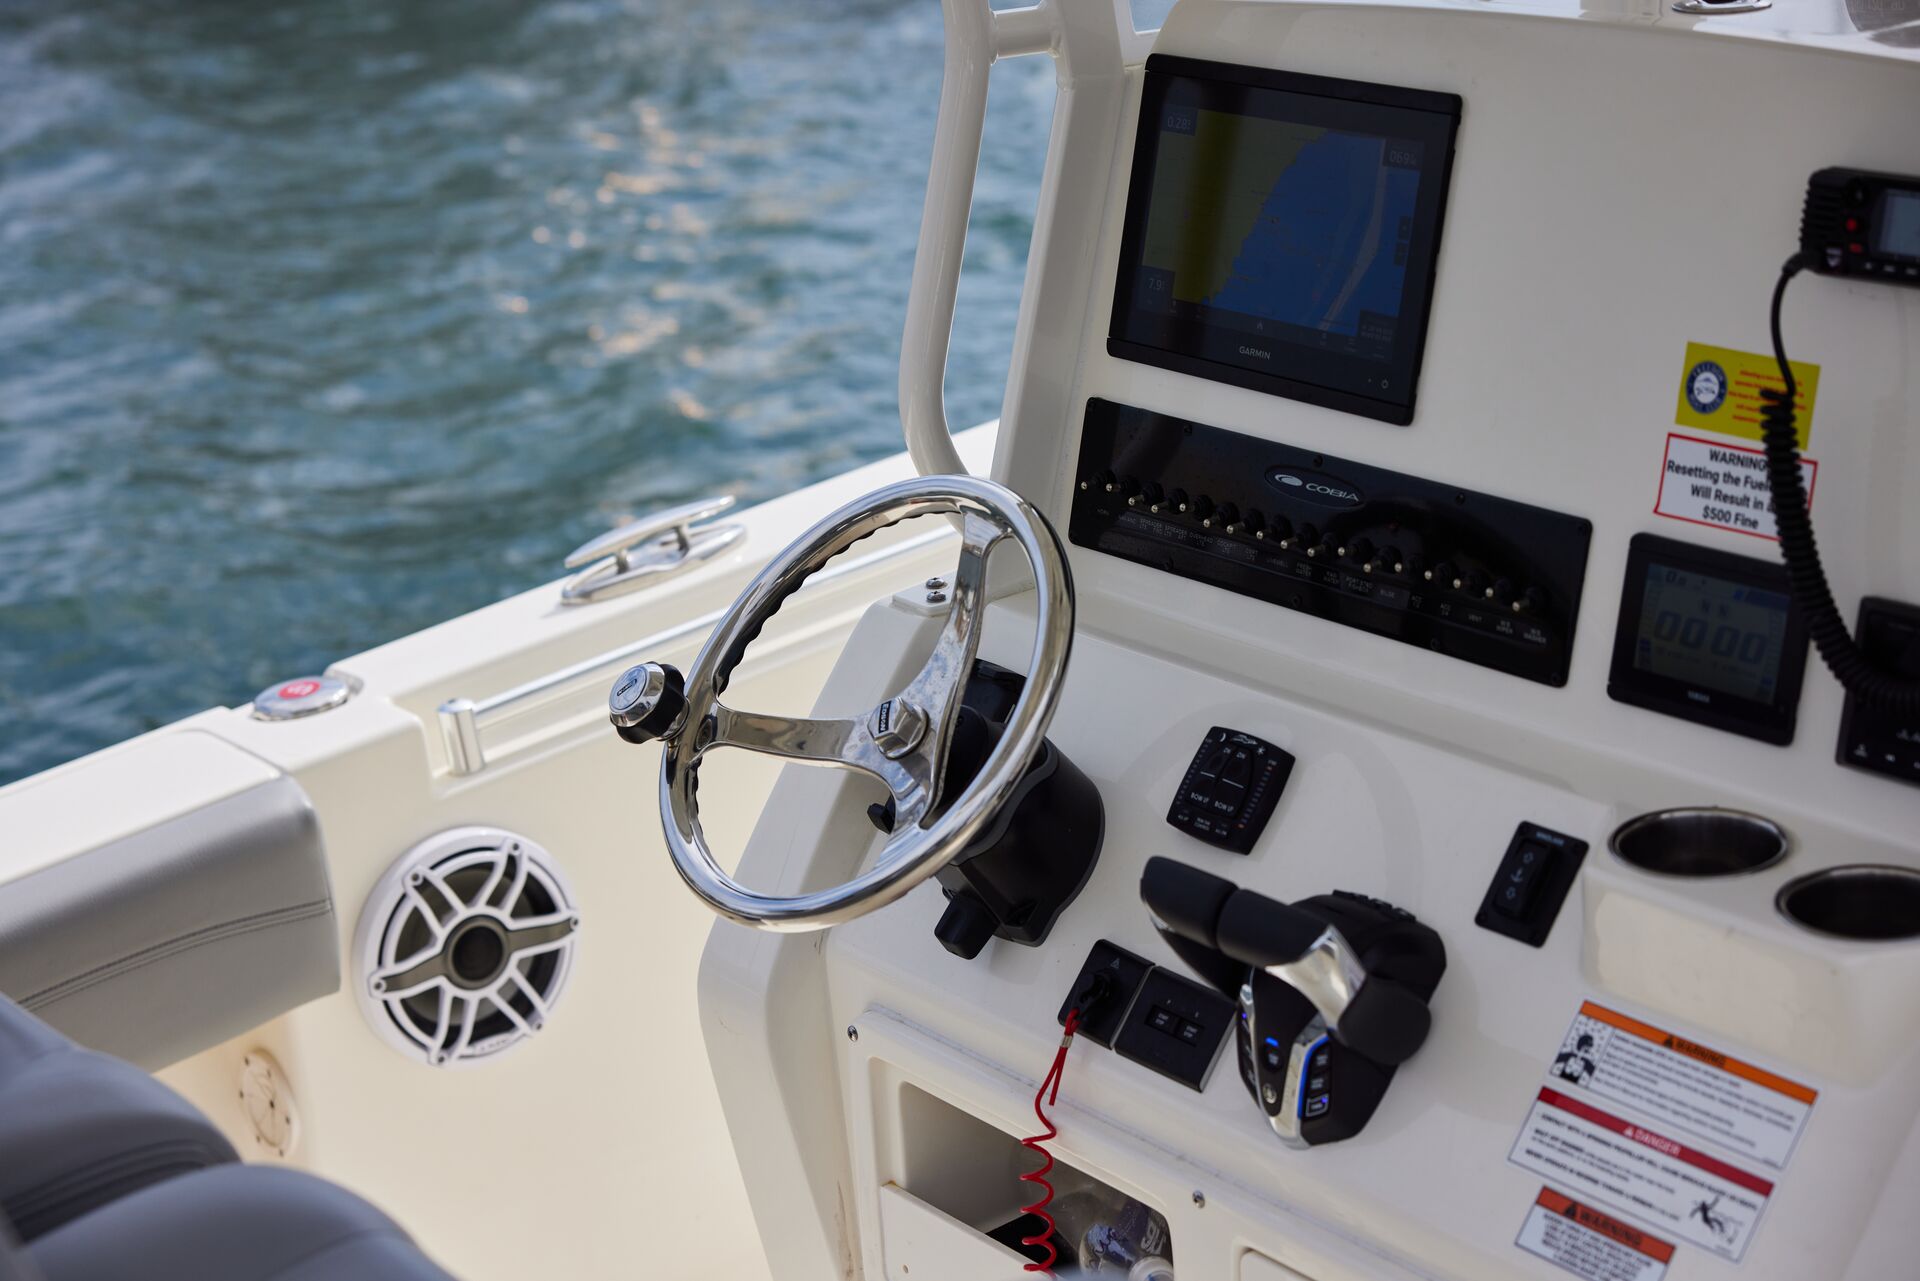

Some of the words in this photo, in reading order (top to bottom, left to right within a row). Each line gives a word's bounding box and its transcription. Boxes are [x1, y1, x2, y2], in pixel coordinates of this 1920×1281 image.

[1239, 345, 1271, 360] GARMIN
[1709, 448, 1767, 472] WARNING
[1667, 460, 1720, 484] Resetting
[1722, 472, 1741, 487] the
[1306, 483, 1359, 502] COBIA
[1691, 484, 1712, 499] Will
[1714, 488, 1750, 509] Result
[1753, 497, 1764, 509] in
[1703, 505, 1731, 523] $500
[1734, 513, 1759, 530] Fine
[880, 703, 889, 731] EDSON
[1634, 1127, 1682, 1157] DANGER
